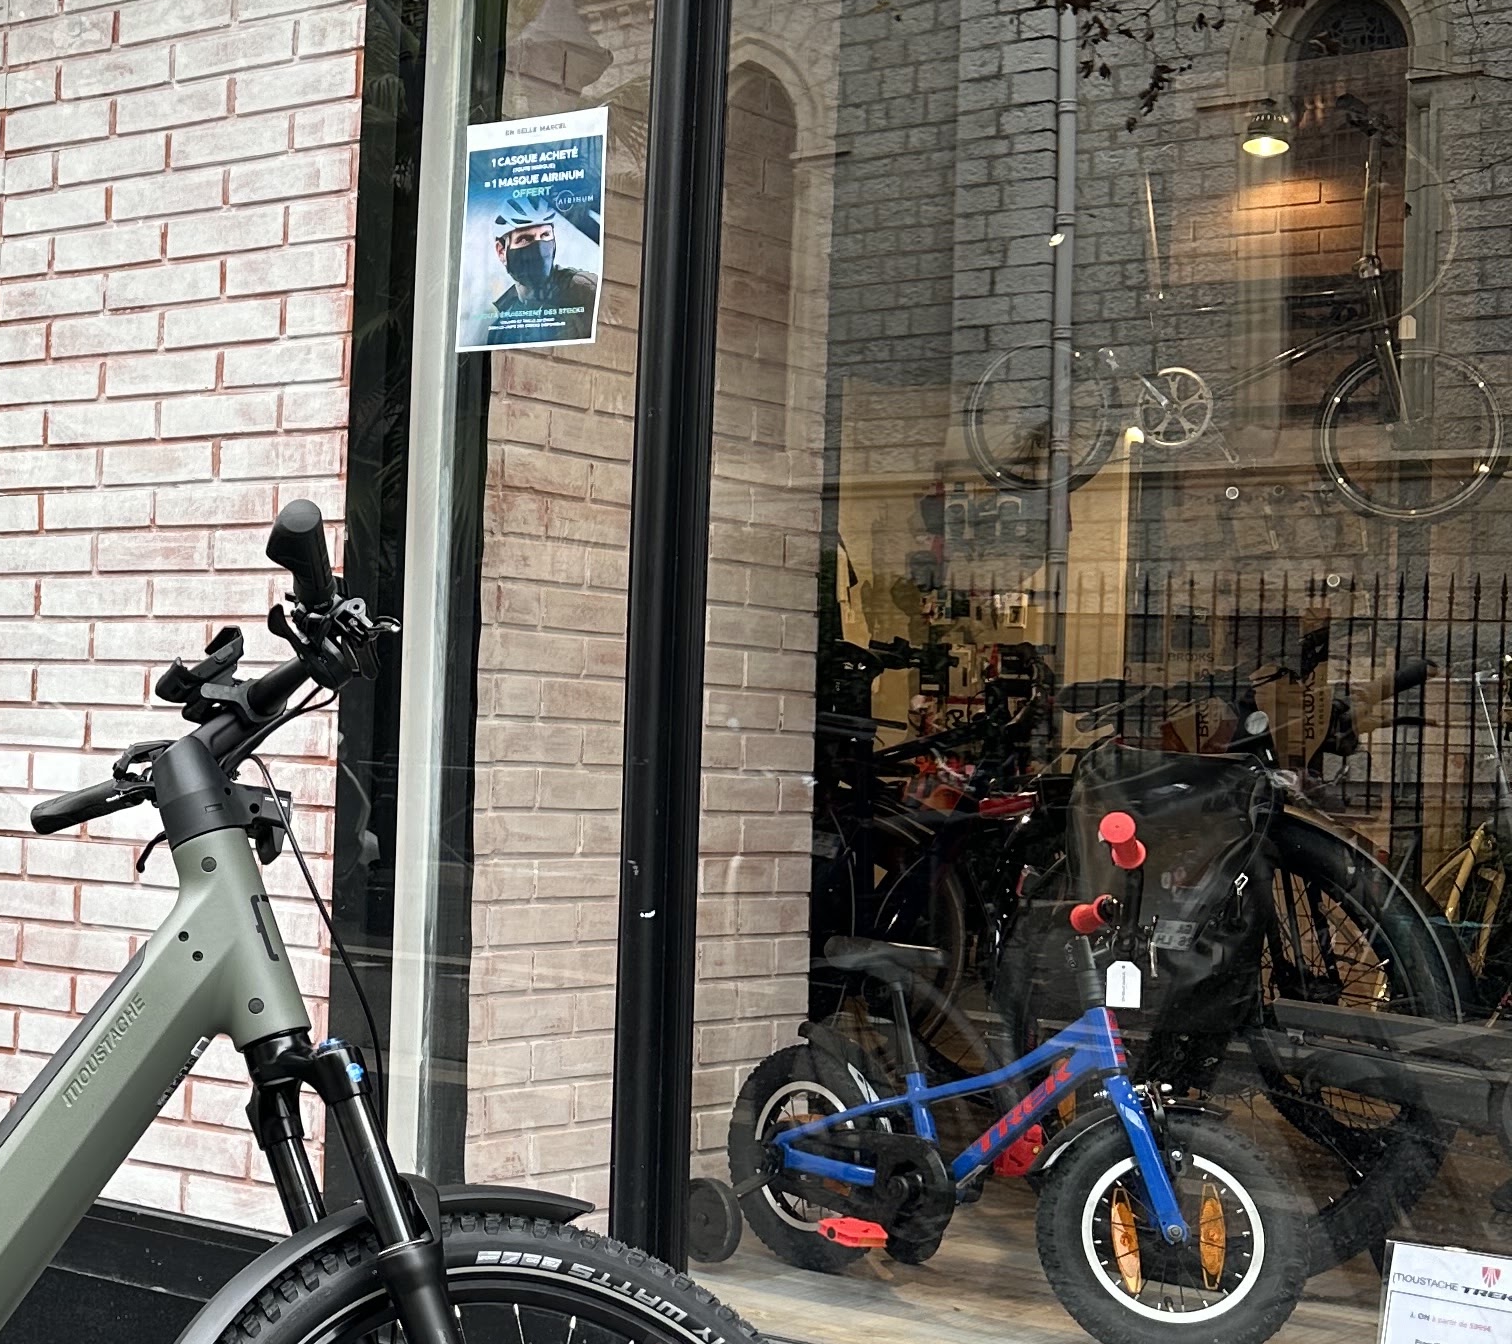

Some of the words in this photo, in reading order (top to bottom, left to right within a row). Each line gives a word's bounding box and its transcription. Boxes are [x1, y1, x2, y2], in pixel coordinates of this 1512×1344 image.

[491, 158, 497, 168] 1
[497, 153, 538, 167] CASQUE
[539, 145, 579, 160] ACHETÉ
[498, 173, 540, 188] MASQUE
[541, 169, 585, 183] AIRINUM
[512, 185, 552, 199] OFFERT
[557, 194, 594, 206] AIRINUM
[61, 991, 147, 1108] MOUSTACHE
[973, 1058, 1073, 1153] TREK
[568, 1262, 688, 1323] WATTS
[1392, 1271, 1459, 1292] MOUSTACHE
